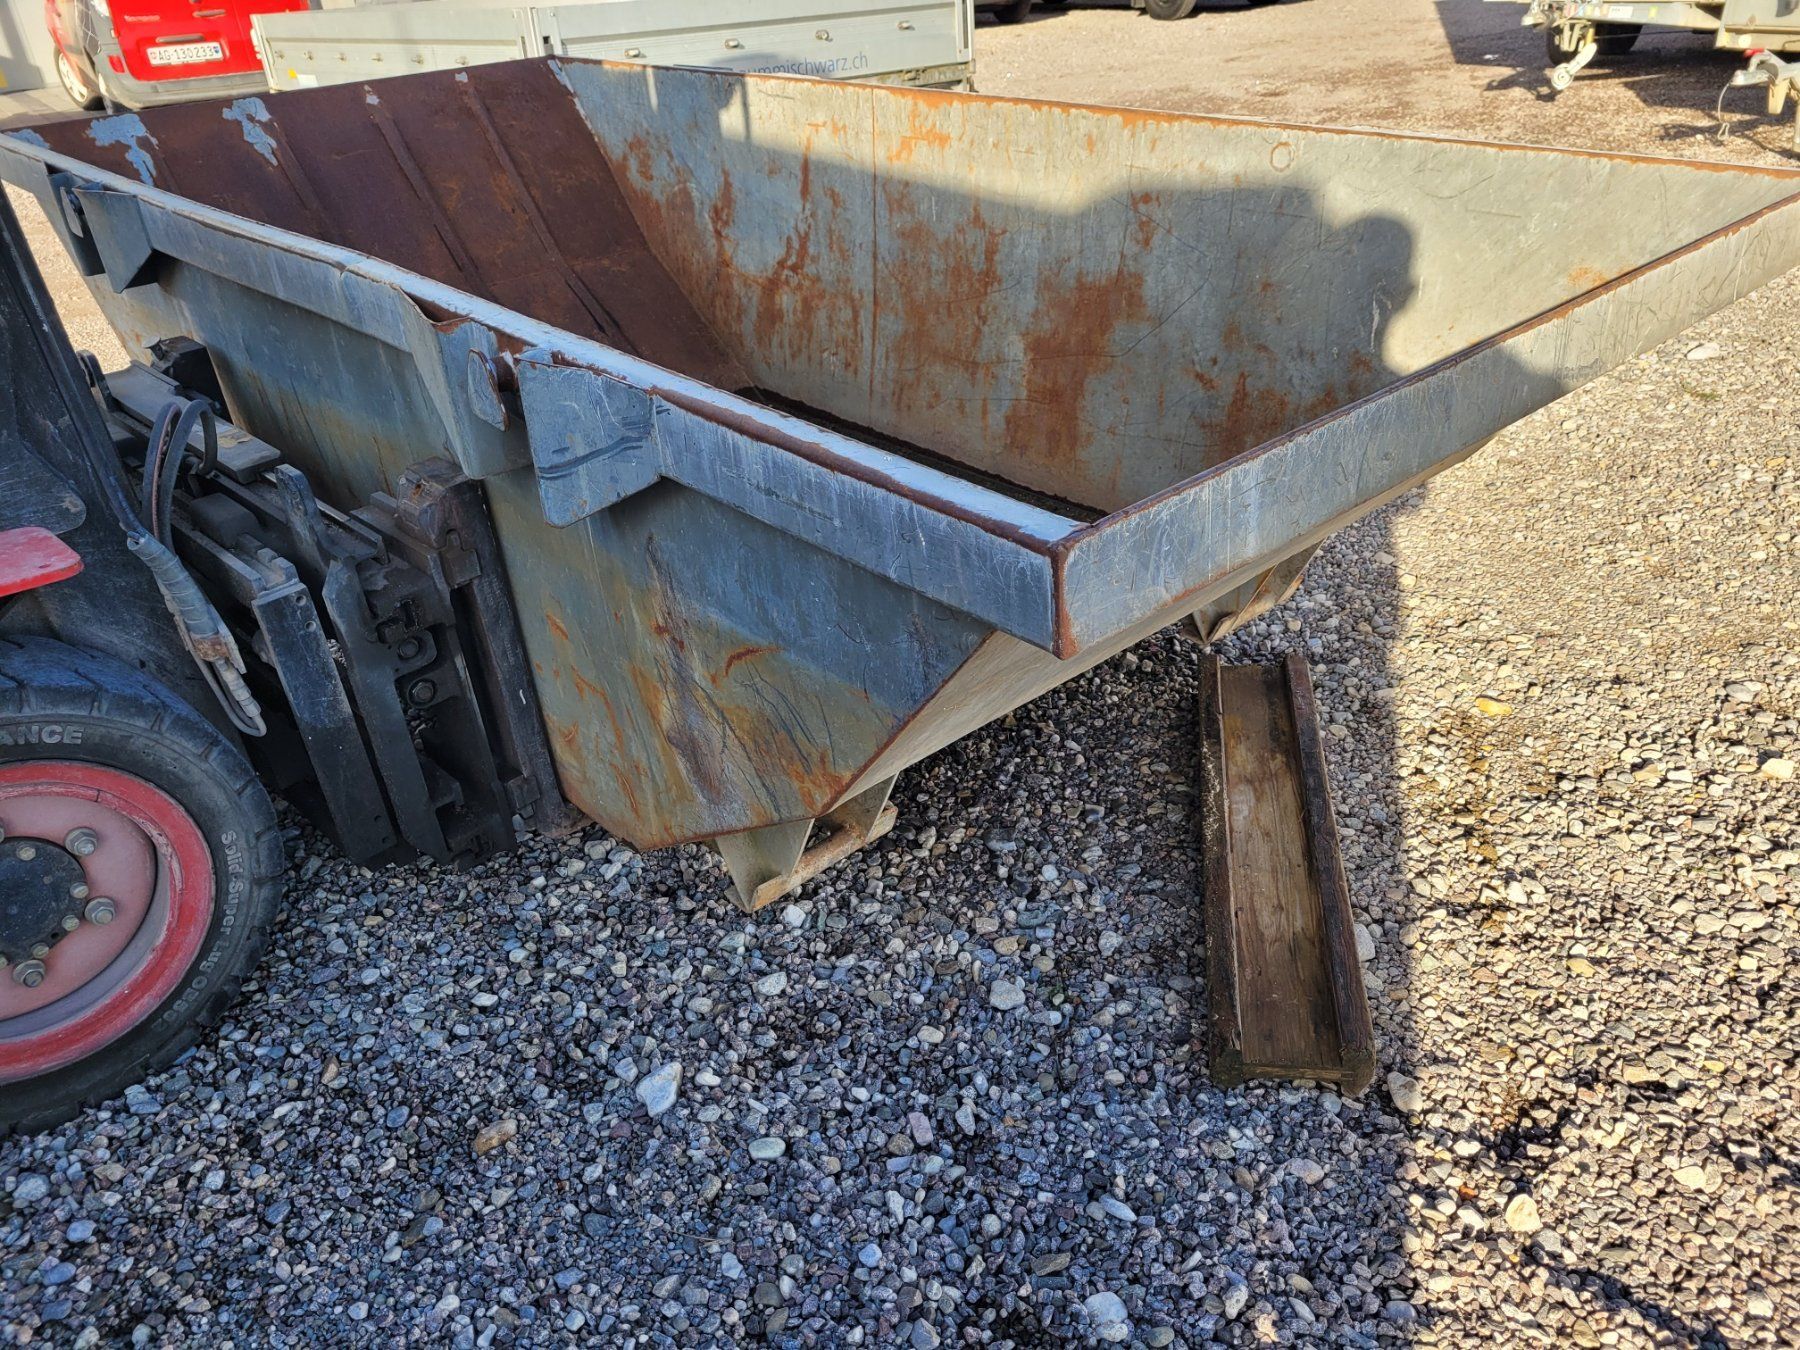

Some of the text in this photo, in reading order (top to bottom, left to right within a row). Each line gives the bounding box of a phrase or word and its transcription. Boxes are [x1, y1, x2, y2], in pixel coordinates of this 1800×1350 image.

[739, 51, 868, 75] mmischwarz.ch
[221, 830, 243, 874] Solid
[220, 881, 244, 935] Super
